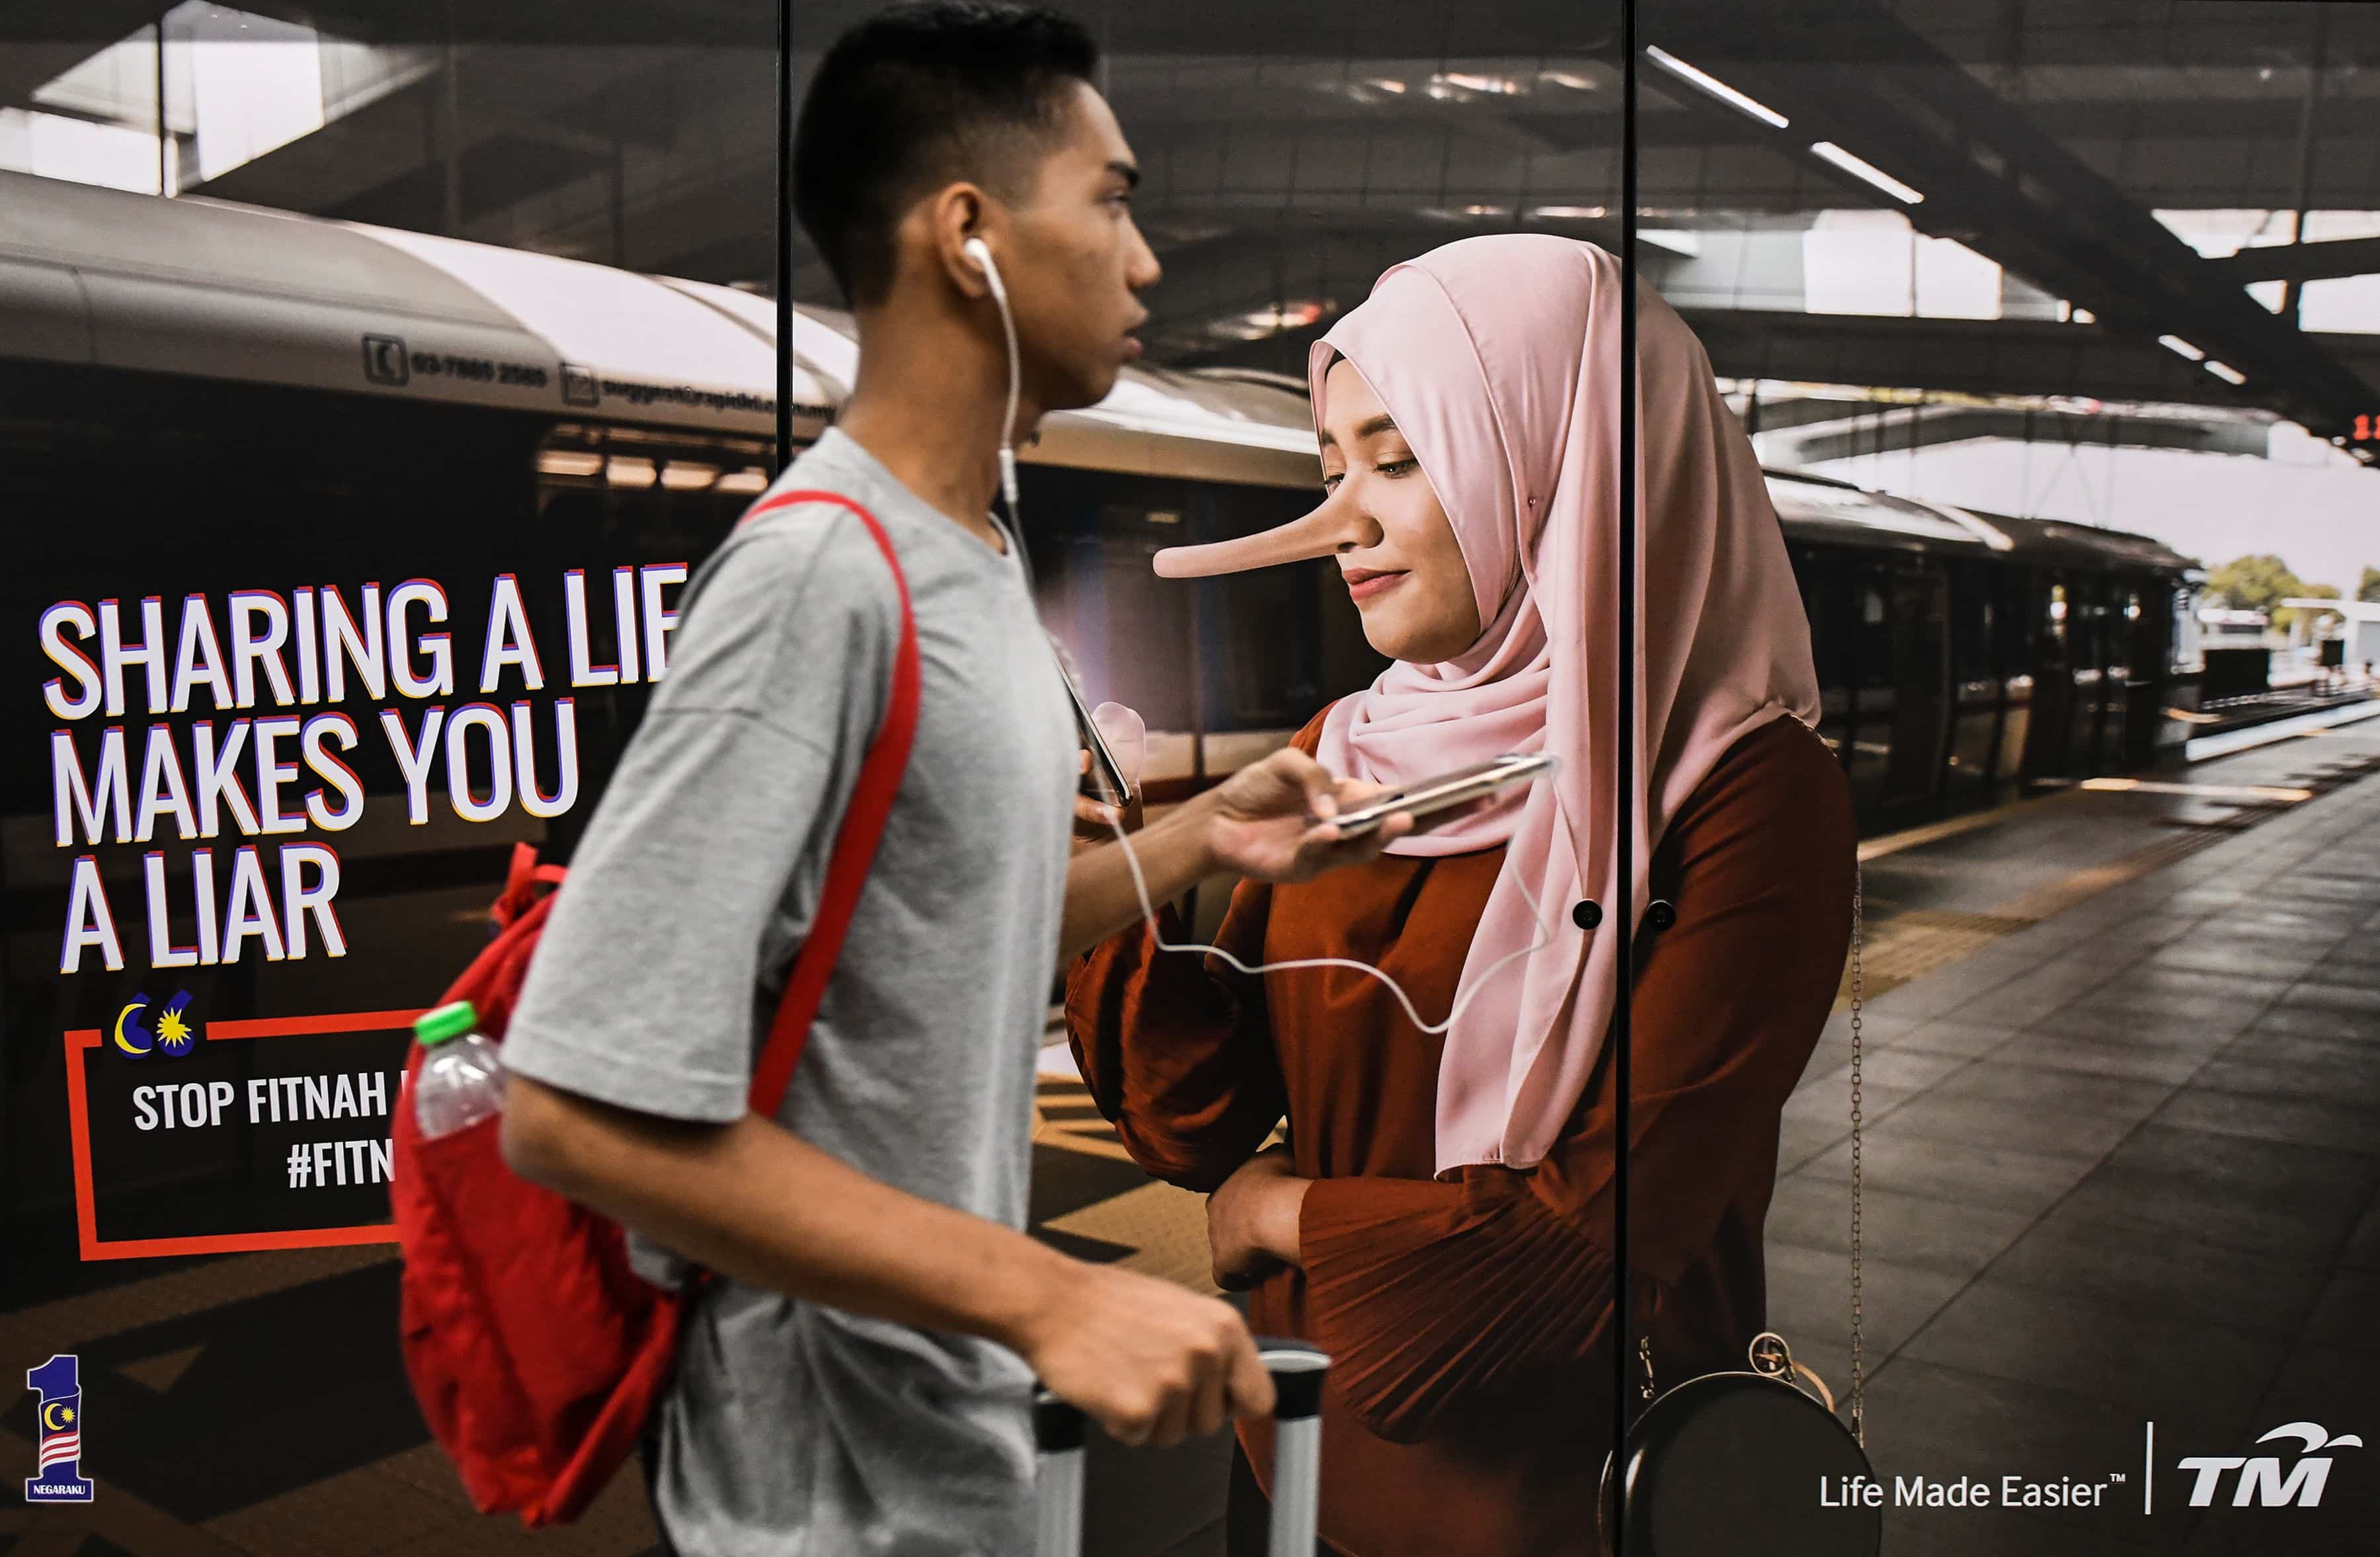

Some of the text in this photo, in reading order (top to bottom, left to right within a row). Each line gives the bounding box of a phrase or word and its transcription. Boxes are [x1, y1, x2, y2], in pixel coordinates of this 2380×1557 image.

[38, 579, 454, 721] SHARING
[479, 573, 545, 693] A
[50, 697, 579, 848] MAKES YOU
[60, 842, 346, 975] A LIAR
[132, 1082, 235, 1132] STOP
[248, 1071, 387, 1124] FITNAH
[33, 1484, 86, 1496] NEGARAKU
[1819, 1475, 1884, 1507] Life
[1895, 1476, 1991, 1507] Made
[2177, 1457, 2333, 1507] TM
